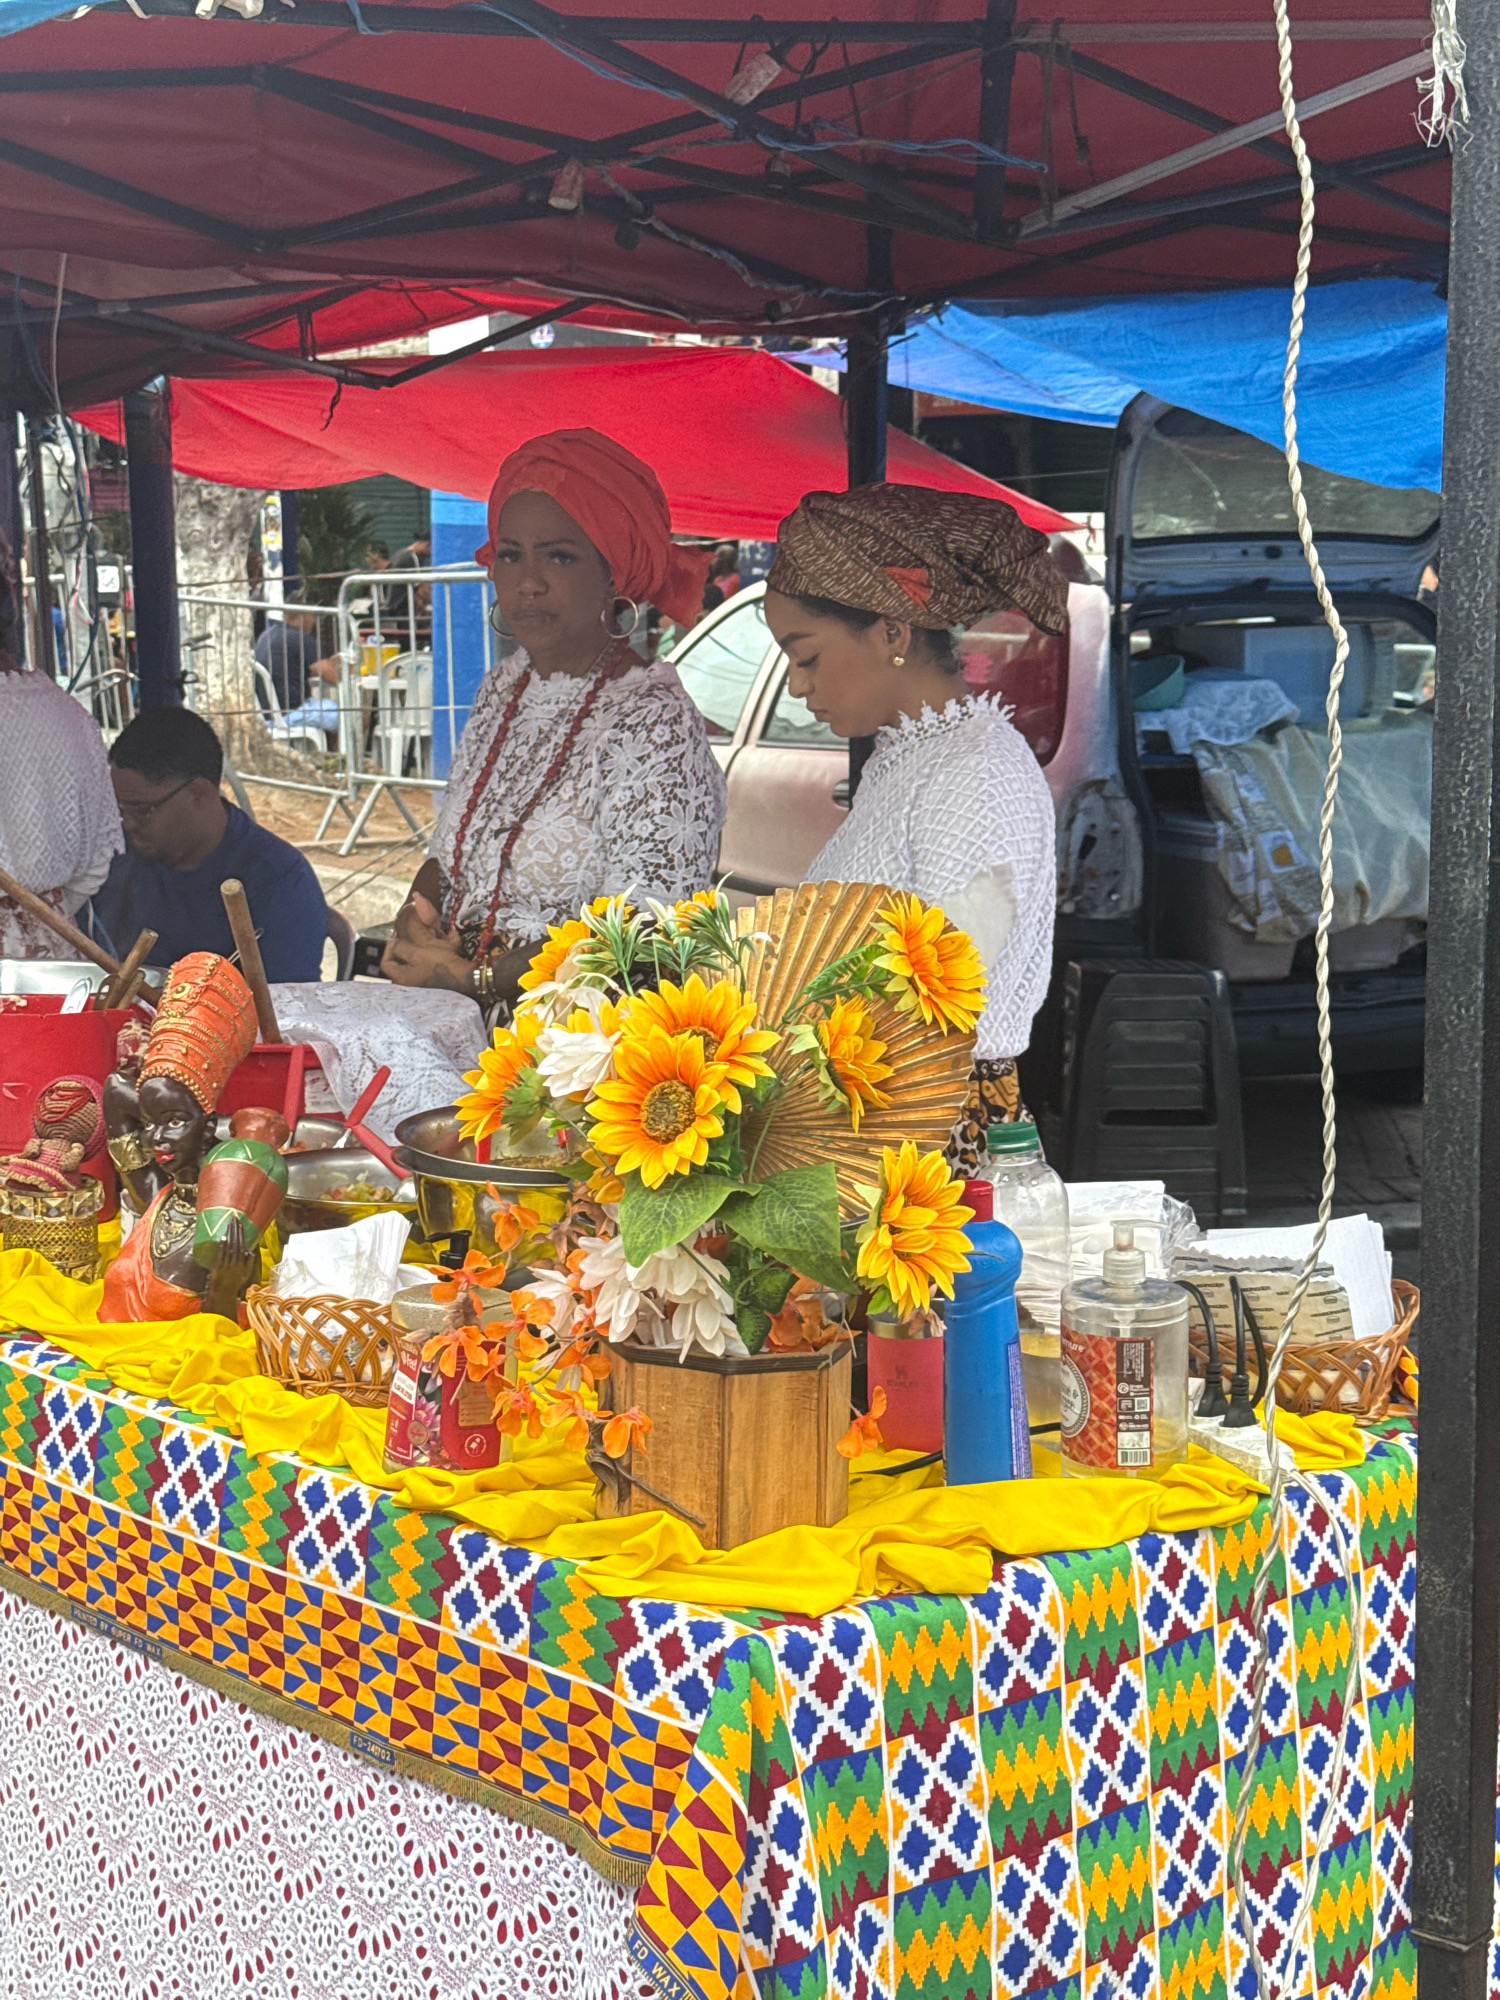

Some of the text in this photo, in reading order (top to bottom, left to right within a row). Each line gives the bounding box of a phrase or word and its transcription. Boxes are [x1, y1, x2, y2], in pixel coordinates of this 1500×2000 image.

[100, 1620, 109, 1632] BY
[146, 1642, 161, 1656] WAX
[632, 1940, 648, 1960] FD
[651, 1962, 681, 1997] WAX
